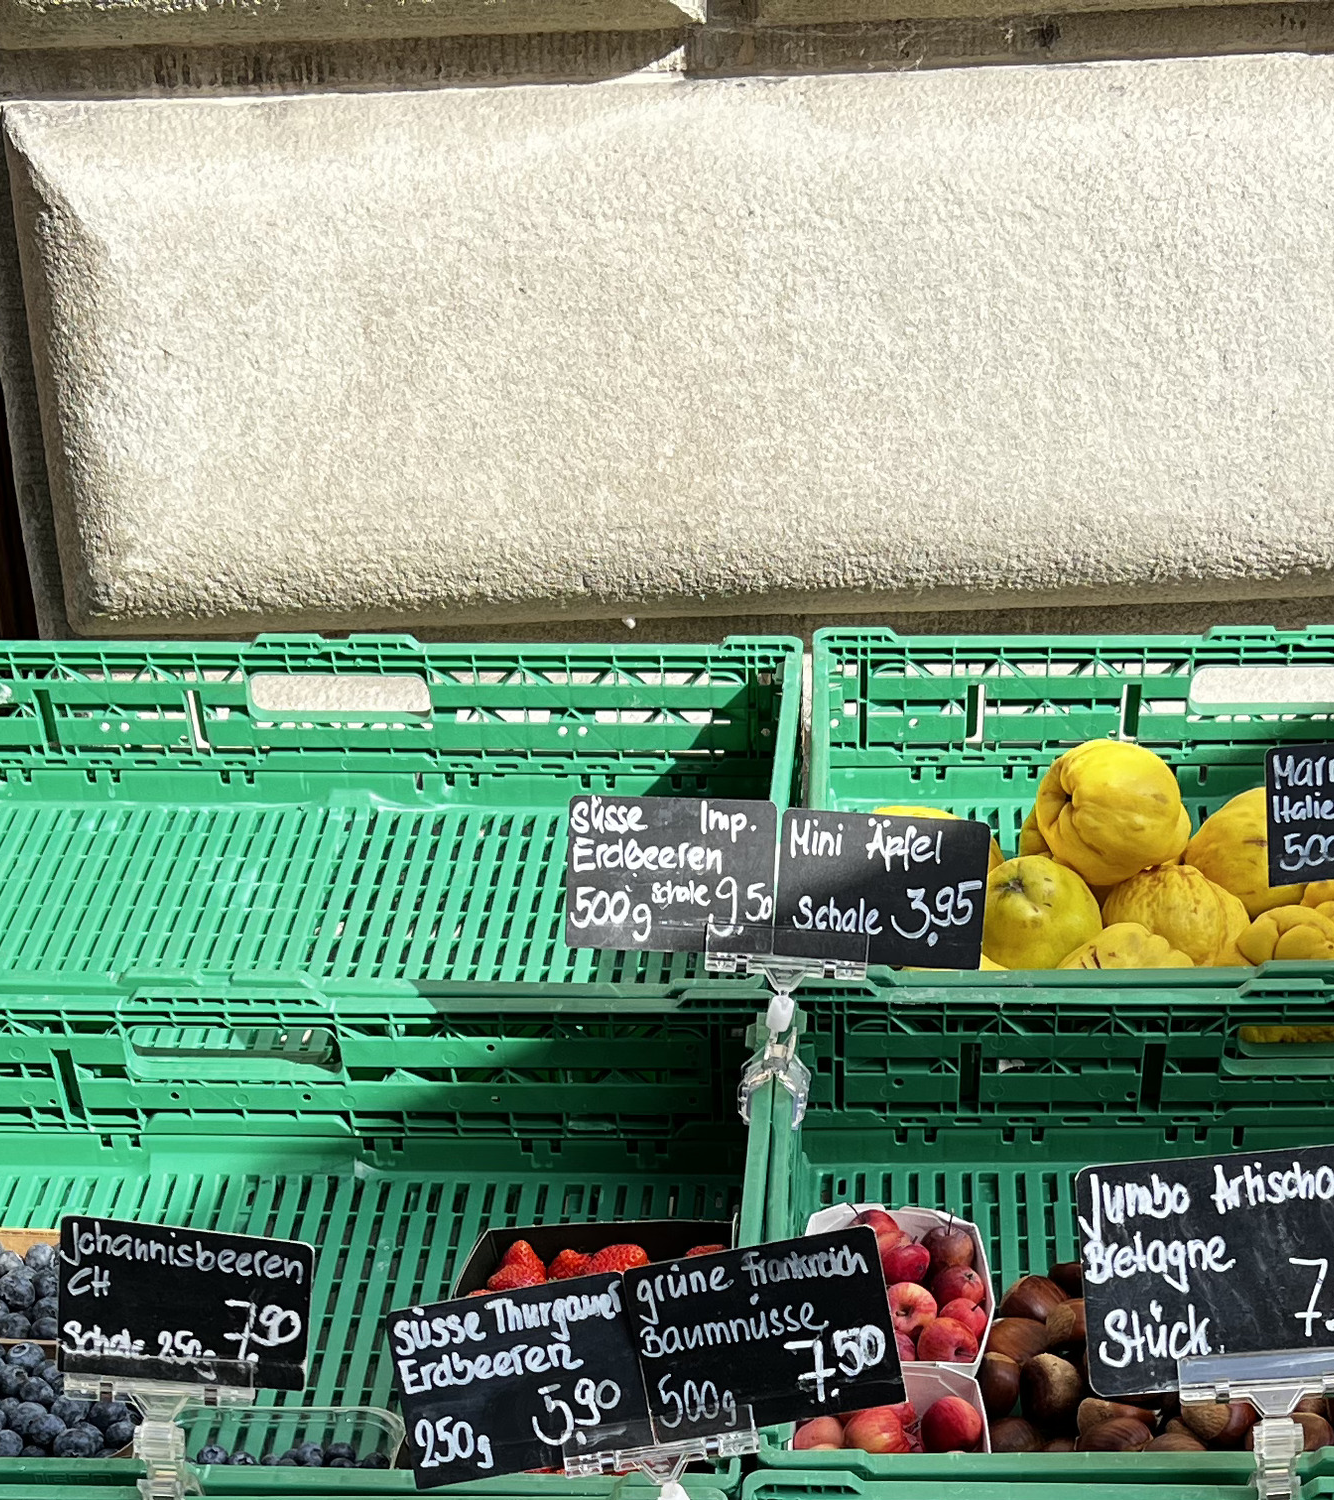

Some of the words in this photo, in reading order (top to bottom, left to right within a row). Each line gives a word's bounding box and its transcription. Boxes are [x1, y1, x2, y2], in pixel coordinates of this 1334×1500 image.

[701, 801, 756, 842] Imp.
[789, 819, 844, 857] Mini
[866, 818, 943, 873] Äpfel
[573, 838, 722, 872] Erdbeeren
[569, 885, 652, 941] 500g
[793, 896, 883, 935] Schale
[891, 881, 983, 946] 3.95
[1078, 1173, 1190, 1242] Jumbo
[60, 1221, 304, 1284] Johannisbeeren
[67, 1265, 111, 1298] CH
[1082, 1231, 1236, 1294] Bretagne
[484, 1281, 623, 1335] Thurgauer
[636, 1263, 734, 1324] grüne
[639, 1293, 829, 1359] Baumnüsse
[1099, 1300, 1212, 1368] Stück
[398, 1341, 584, 1395] Erdbeeren
[414, 1417, 494, 1469] 250g
[532, 1377, 621, 1446] 5.90
[659, 1374, 738, 1430] 500g
